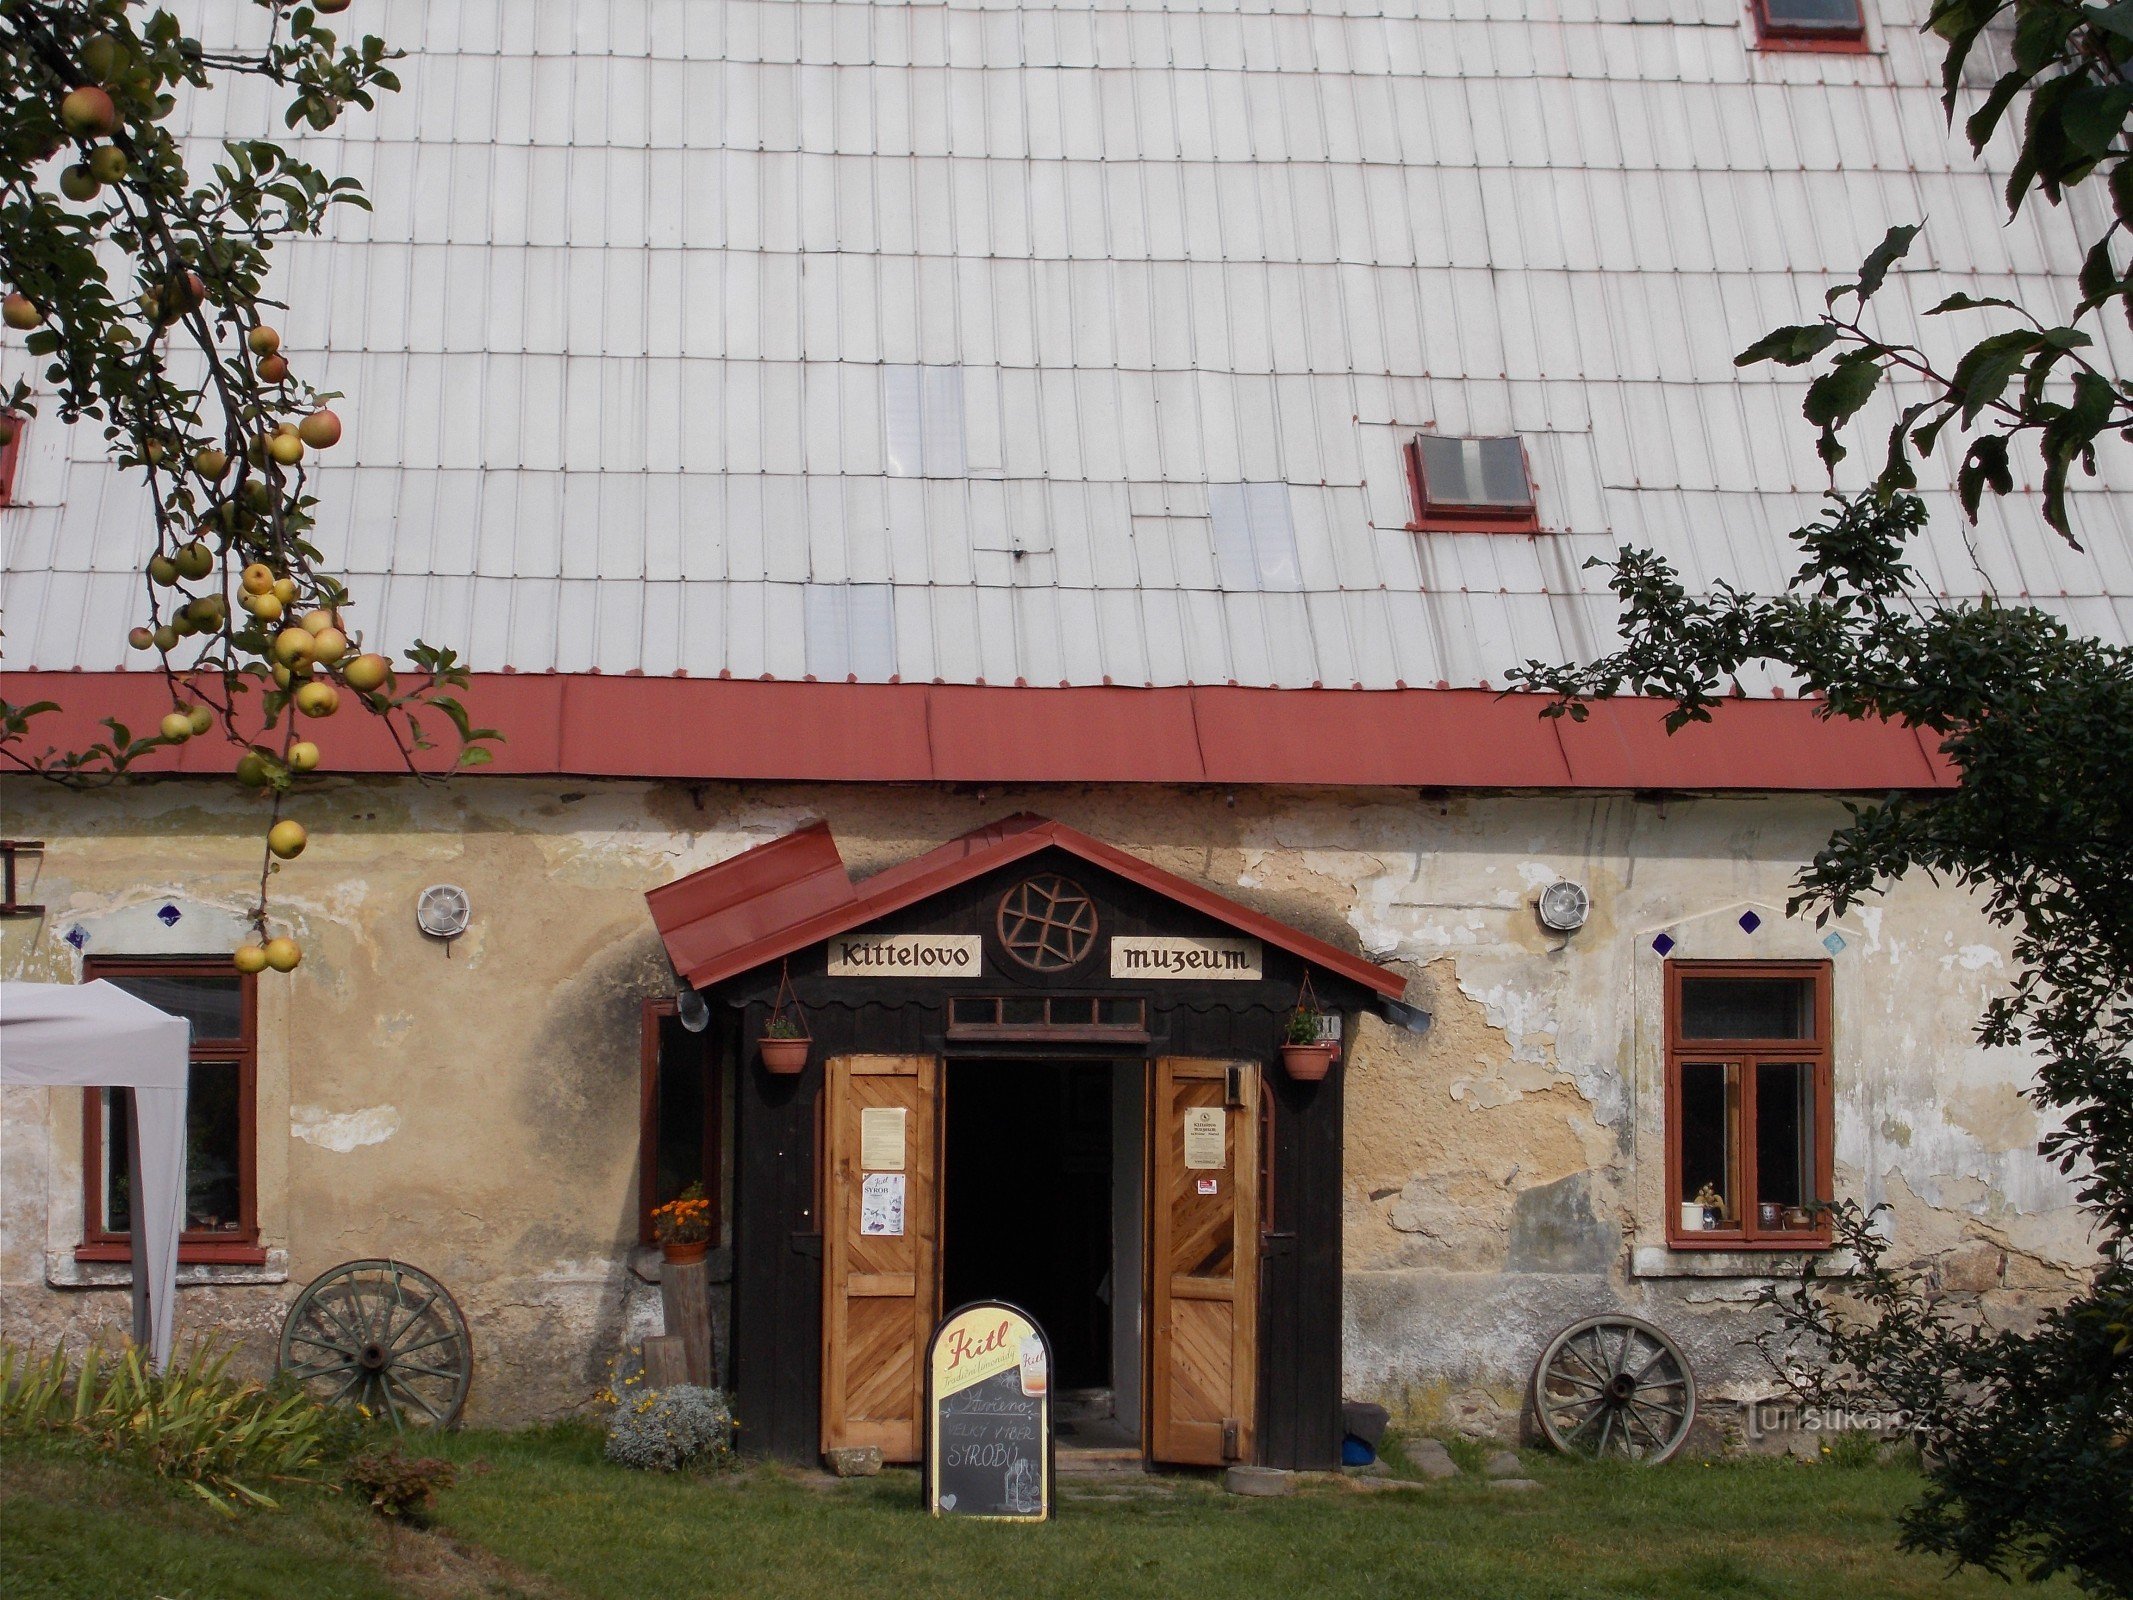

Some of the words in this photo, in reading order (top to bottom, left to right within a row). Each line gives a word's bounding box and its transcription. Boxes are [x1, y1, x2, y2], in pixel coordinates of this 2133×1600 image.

[840, 942, 970, 967] Kittelovo
[1123, 948, 1250, 973] muzeum
[947, 1320, 1010, 1370] Kitl
[1022, 1350, 1044, 1368] Kitl
